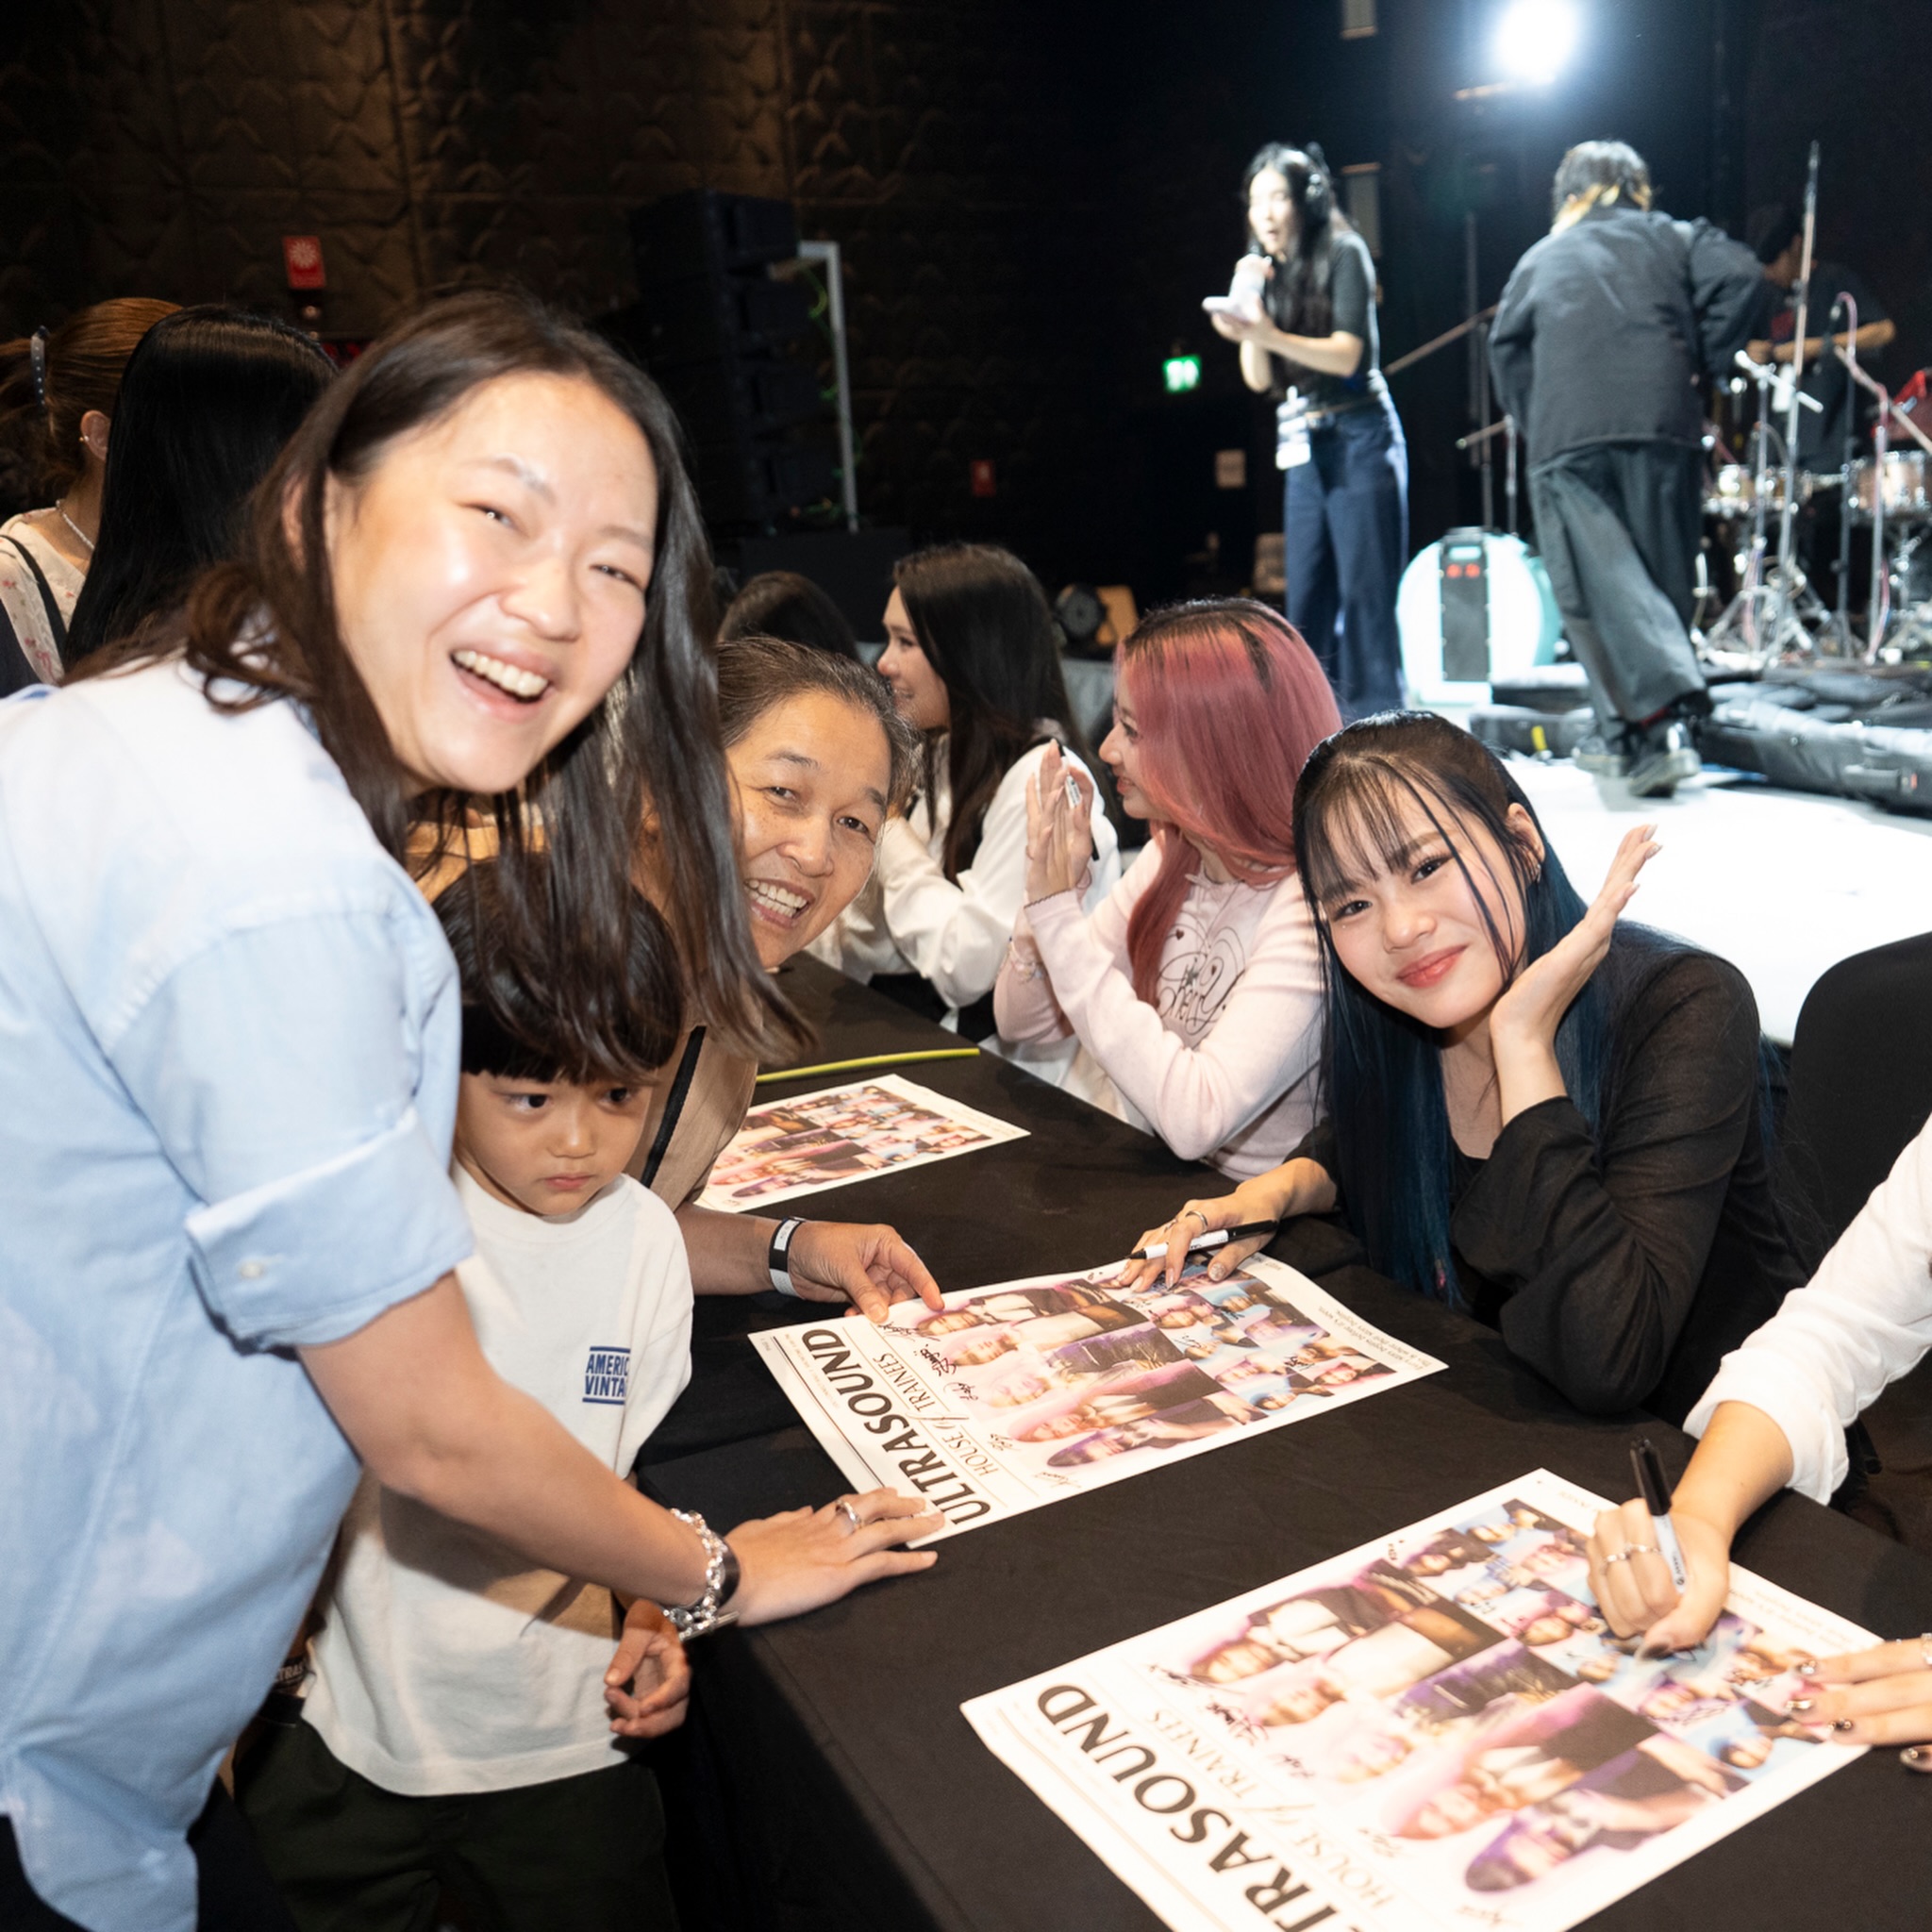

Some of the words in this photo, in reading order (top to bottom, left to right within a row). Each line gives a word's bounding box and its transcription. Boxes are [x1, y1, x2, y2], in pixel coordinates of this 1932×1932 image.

[801, 1327, 991, 1525] ULTRASOUND
[872, 1353, 936, 1412] TRAINEES
[941, 1431, 999, 1477] HOUSE
[1038, 1684, 1361, 1932] TRASOUND
